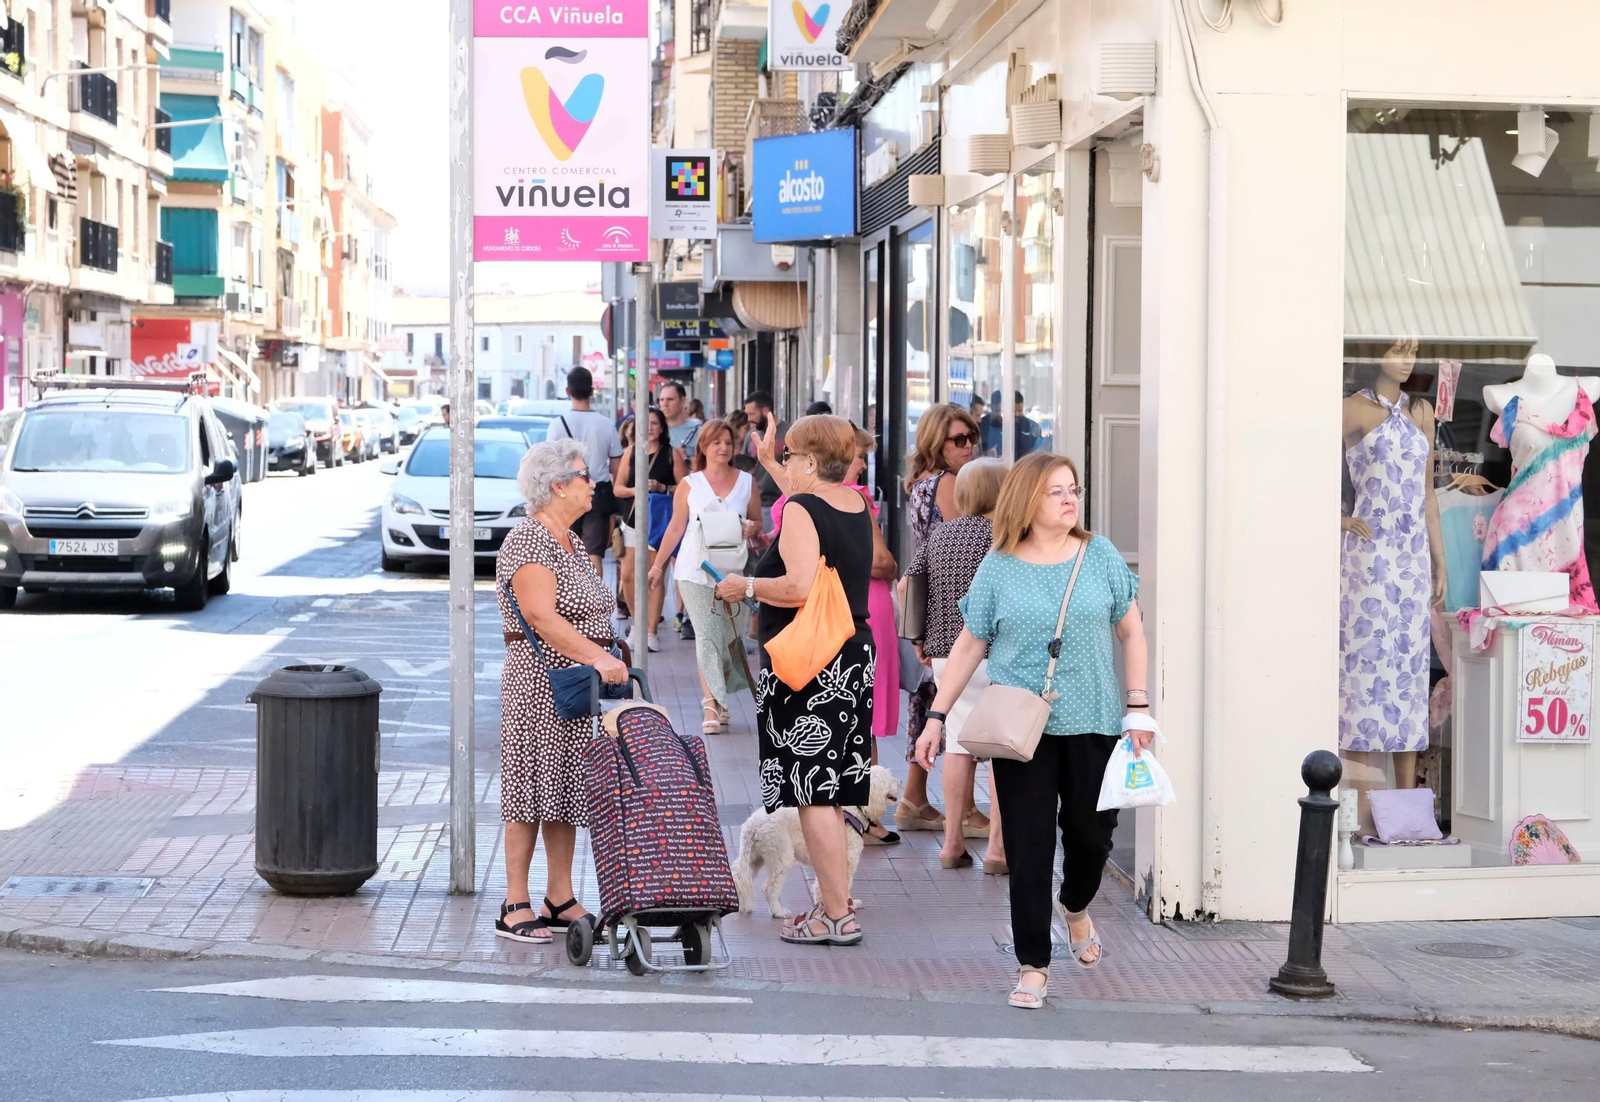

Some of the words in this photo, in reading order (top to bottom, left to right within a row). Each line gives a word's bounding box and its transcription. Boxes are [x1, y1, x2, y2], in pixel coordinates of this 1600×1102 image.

[500, 6, 542, 24] CCA
[548, 5, 624, 24] Viñuela
[780, 52, 842, 66] viñuela
[503, 166, 547, 175] CENTRO
[552, 166, 618, 175] COMERCIAL
[495, 178, 630, 209] viñuela
[779, 170, 825, 203] alcosto
[57, 541, 88, 552] 7524
[92, 541, 115, 552] JXS
[1525, 655, 1588, 692] Rebajas
[1525, 697, 1586, 737] 50%
